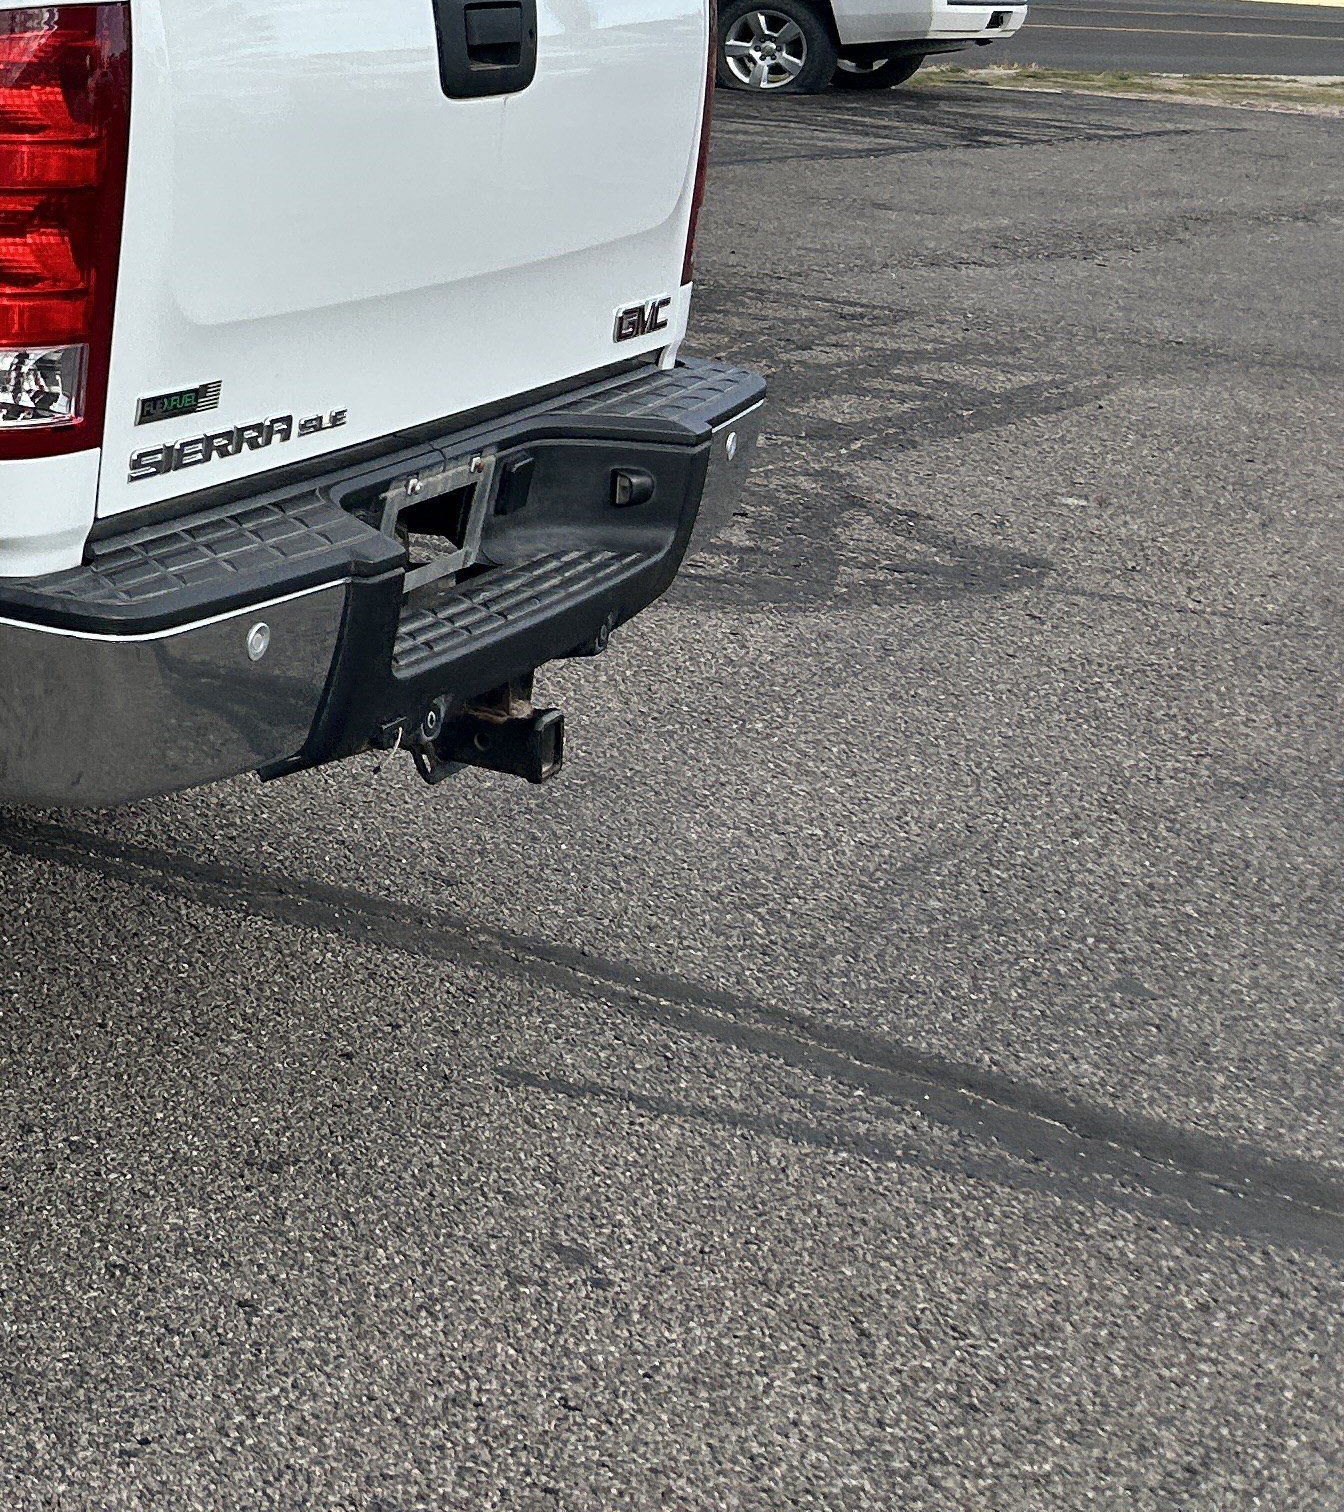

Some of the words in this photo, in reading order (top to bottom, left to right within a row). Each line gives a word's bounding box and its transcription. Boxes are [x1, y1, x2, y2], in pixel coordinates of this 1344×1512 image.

[612, 294, 672, 344] GMC
[126, 411, 294, 484] SIERRA
[297, 405, 349, 439] SLE
